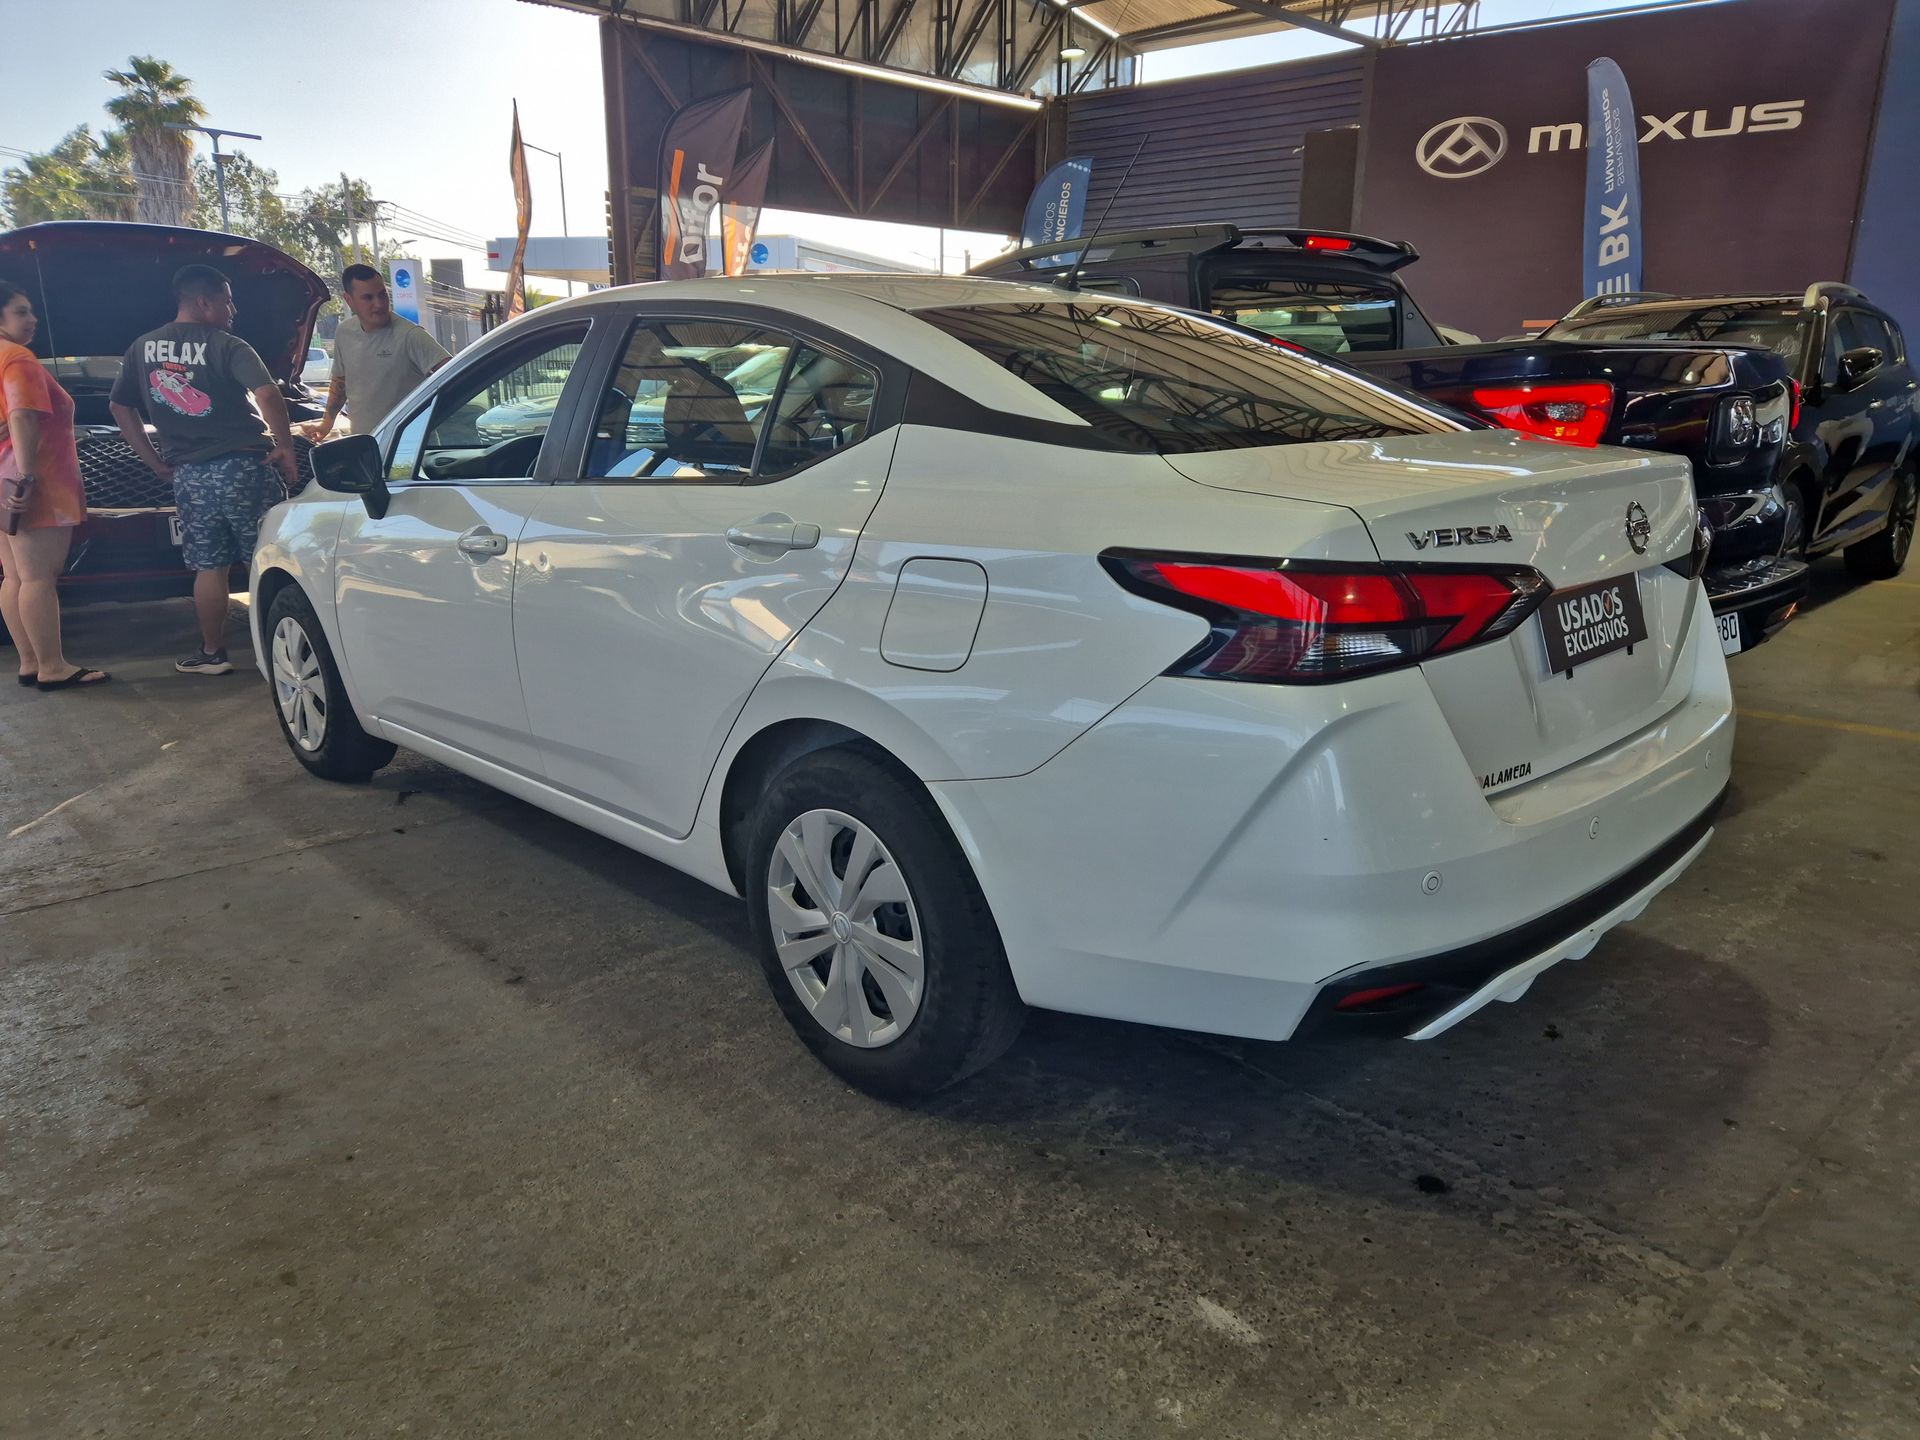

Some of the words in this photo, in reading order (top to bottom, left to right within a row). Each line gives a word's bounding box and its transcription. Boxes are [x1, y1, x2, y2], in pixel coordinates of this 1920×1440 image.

[1052, 182, 1072, 262] FANCIEROS
[144, 339, 207, 366] RELAX
[1405, 524, 1513, 550] VERSA
[1557, 586, 1624, 633] USADOS
[1563, 615, 1630, 657] EXCLUSIVOS
[1482, 761, 1532, 789] ALAMEDA
